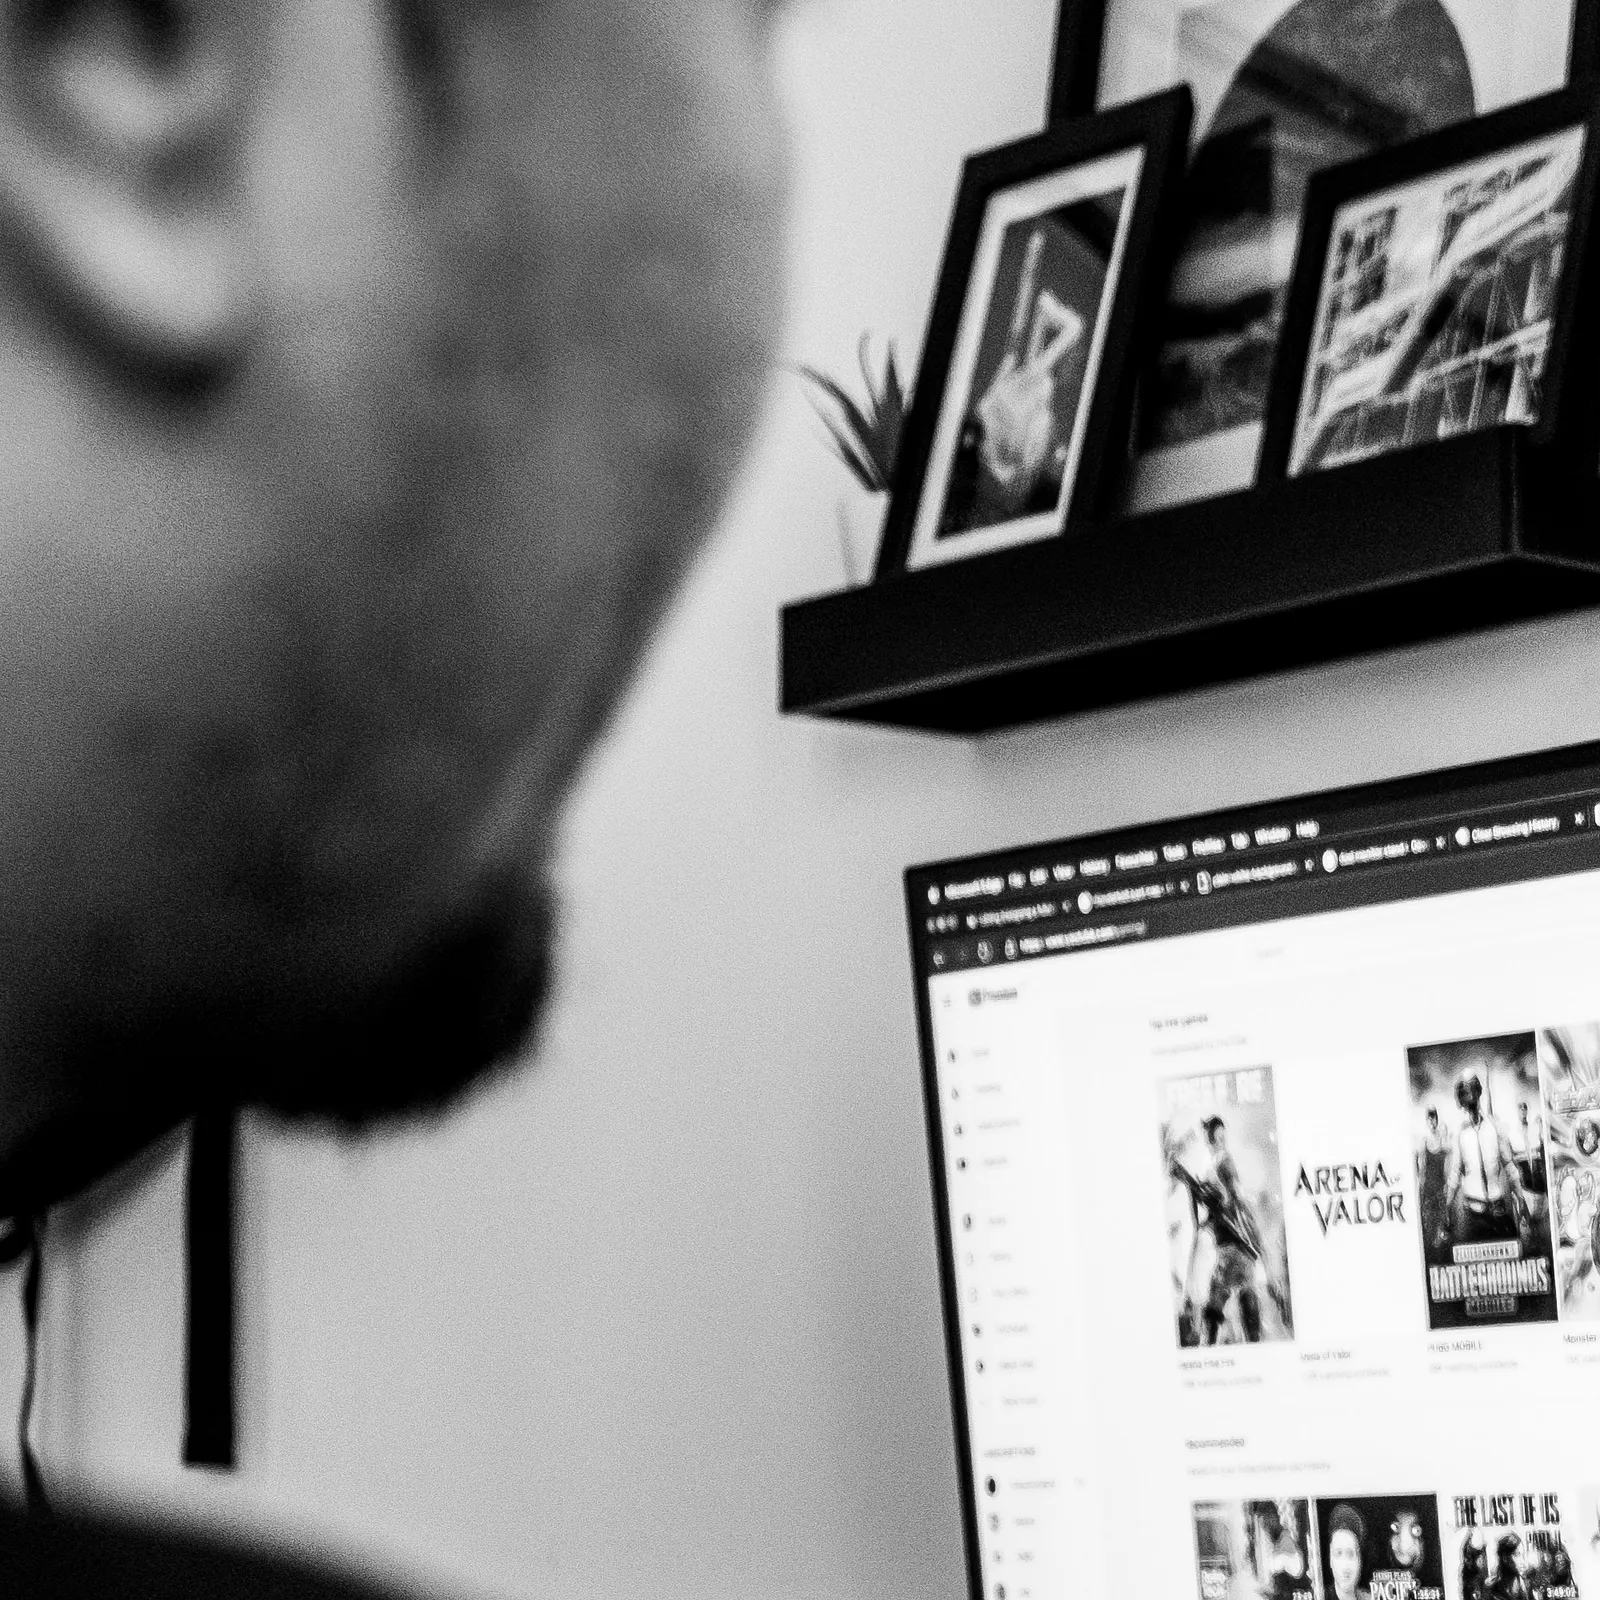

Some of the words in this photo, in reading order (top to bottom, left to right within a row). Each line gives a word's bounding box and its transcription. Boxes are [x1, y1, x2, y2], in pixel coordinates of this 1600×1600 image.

[1293, 1159, 1391, 1197] ARENA
[1311, 1191, 1407, 1240] VALOR
[1452, 1494, 1477, 1530] THE
[1480, 1493, 1515, 1527] LAST
[1539, 1491, 1561, 1525] US
